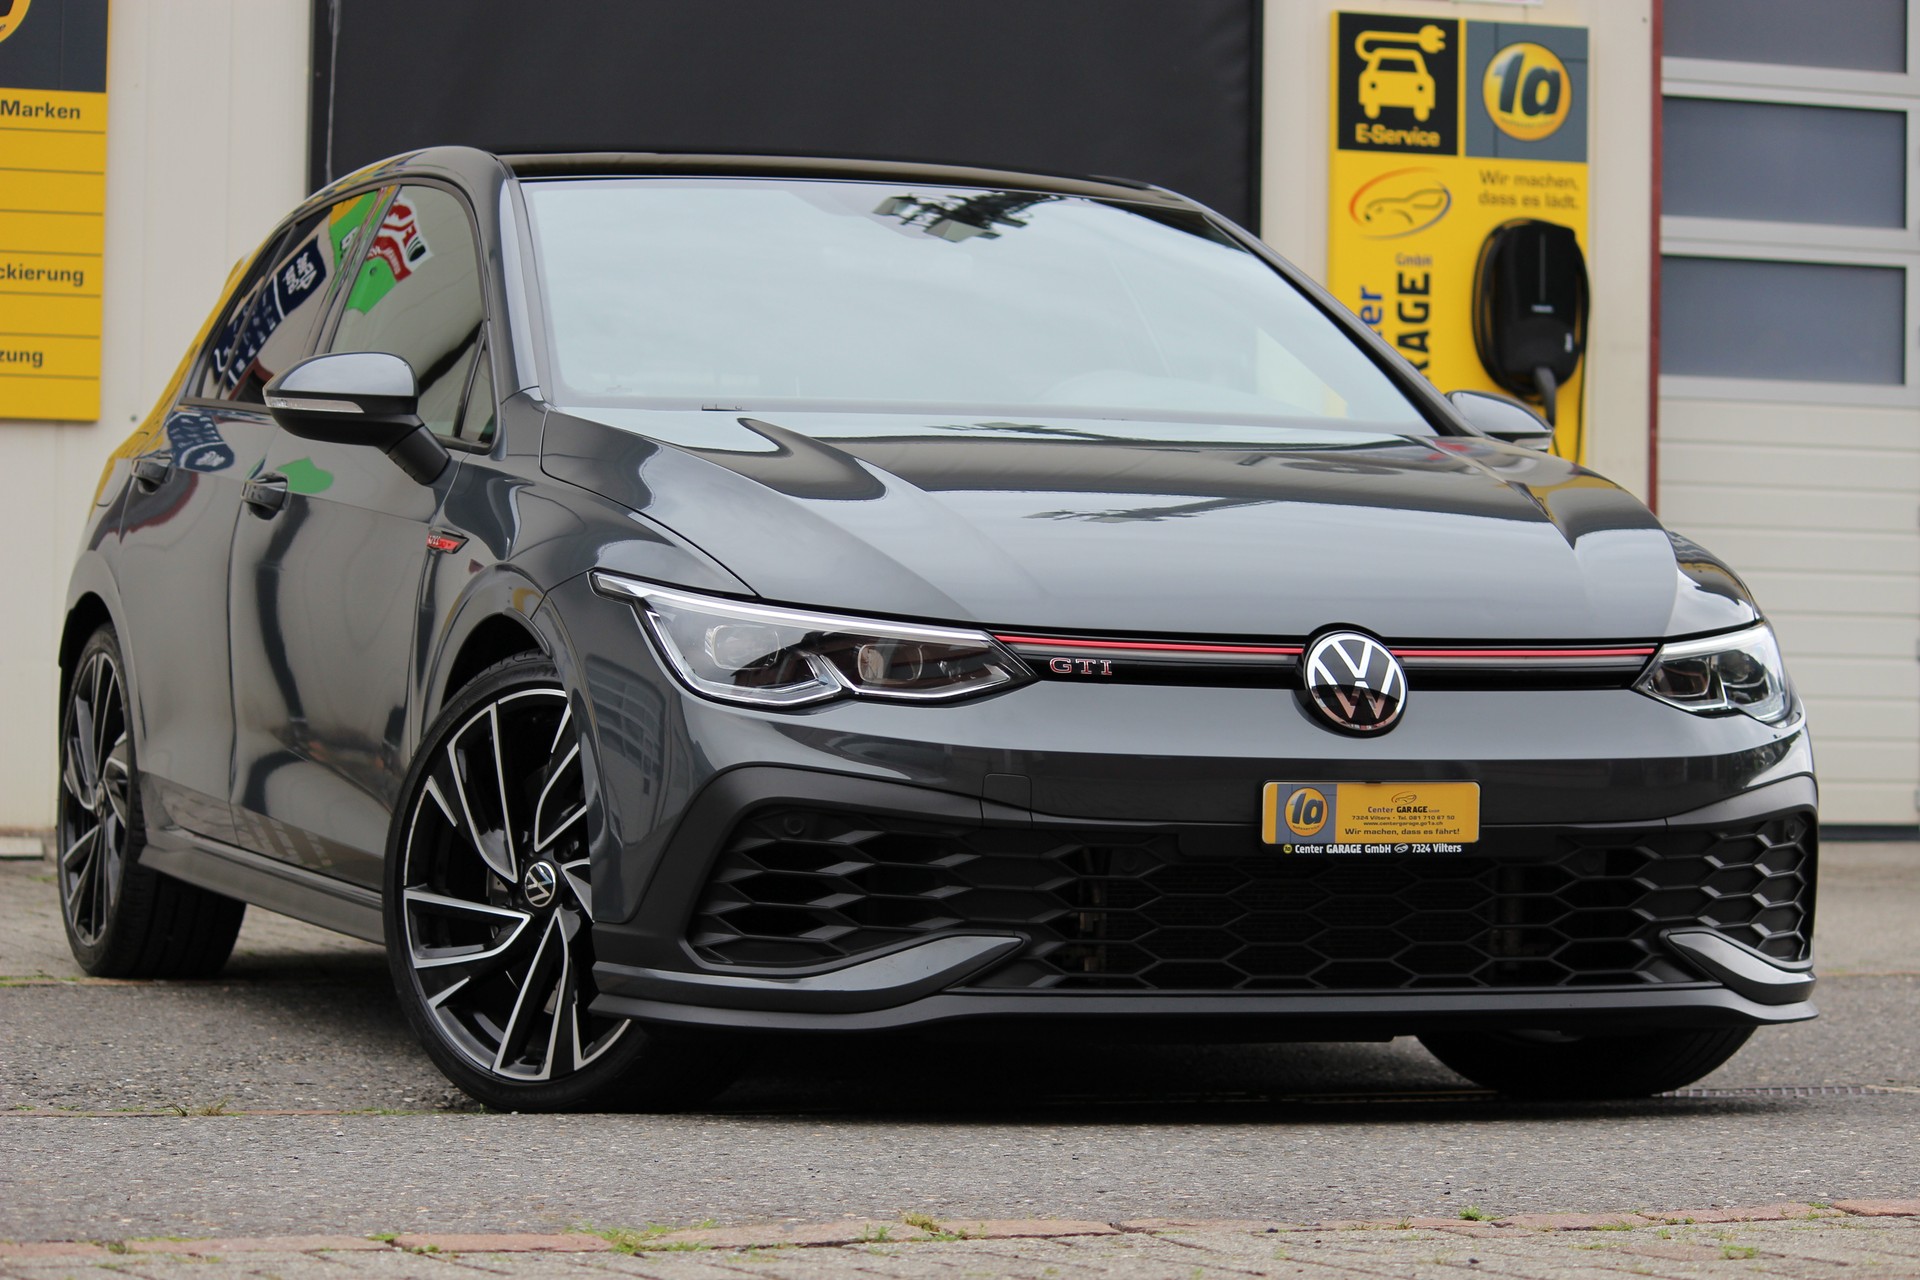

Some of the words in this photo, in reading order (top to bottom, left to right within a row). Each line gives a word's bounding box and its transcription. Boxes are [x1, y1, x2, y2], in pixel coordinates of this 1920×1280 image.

[0, 100, 81, 119] Marken
[1355, 123, 1440, 147] E-Service
[1479, 170, 1509, 185] Wir
[1478, 191, 1517, 206] dass
[1521, 195, 1541, 207] es
[1050, 657, 1113, 675] GTI
[1363, 828, 1399, 836] machen,
[1294, 844, 1323, 854] Center
[1326, 844, 1362, 854] GARAGE
[1364, 844, 1392, 854] GmbH
[1411, 844, 1431, 853] 7324
[1432, 843, 1462, 853] Vilters
